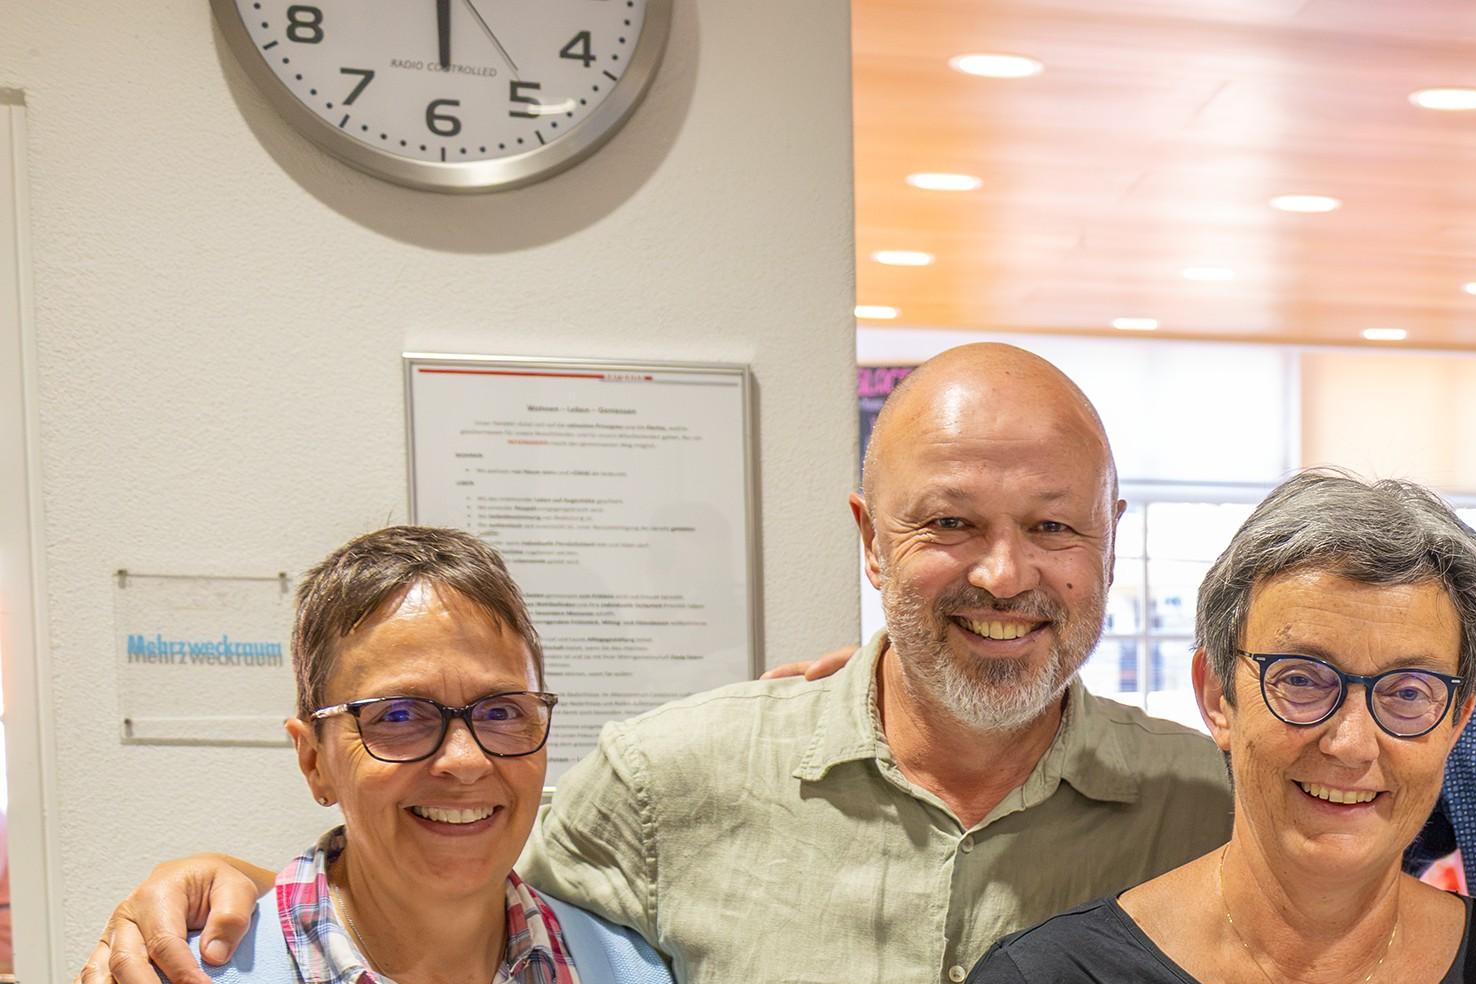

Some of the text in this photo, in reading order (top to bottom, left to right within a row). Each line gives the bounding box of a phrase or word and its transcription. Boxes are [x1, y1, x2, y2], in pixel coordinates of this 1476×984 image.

[285, 5, 324, 44] 8
[390, 58, 498, 77] RADIO COTROLLED
[559, 31, 597, 68] 4
[339, 68, 375, 106] 7
[508, 81, 541, 119] 5
[425, 99, 461, 137] 6
[127, 634, 282, 657] Mehrzweckraum
